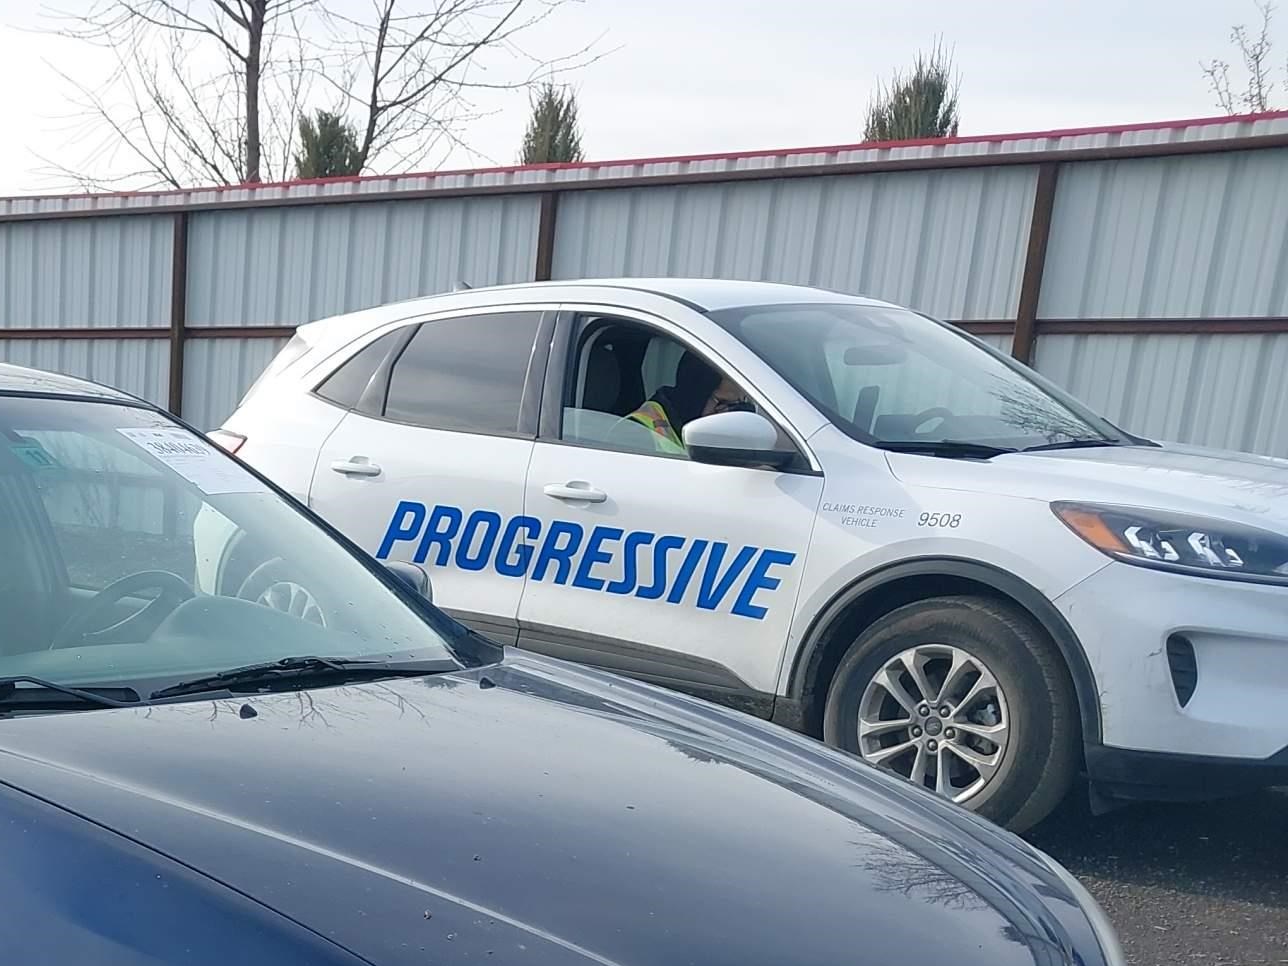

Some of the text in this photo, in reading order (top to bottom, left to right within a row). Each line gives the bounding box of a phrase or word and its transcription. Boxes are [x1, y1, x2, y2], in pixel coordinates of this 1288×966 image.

[822, 502, 905, 518] CLAIMS RESPONSE
[841, 516, 879, 528] VEHICLE
[917, 511, 962, 529] 9508
[376, 500, 797, 620] PROGRESSIVE
